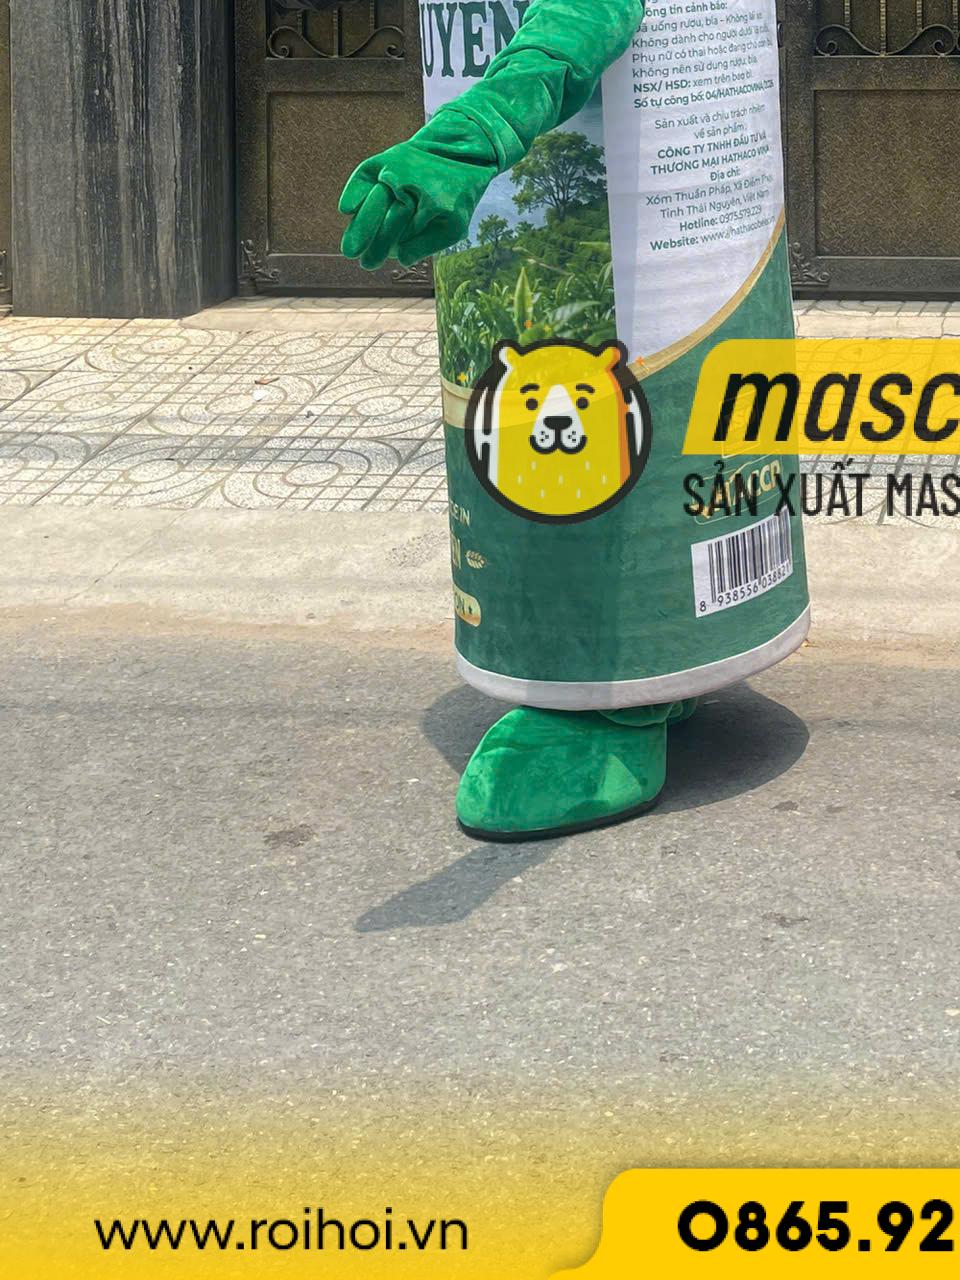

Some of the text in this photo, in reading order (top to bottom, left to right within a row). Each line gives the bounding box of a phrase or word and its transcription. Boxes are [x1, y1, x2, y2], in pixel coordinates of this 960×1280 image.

[657, 144, 691, 159] CÔNG
[693, 143, 705, 155] TY
[707, 139, 732, 152] TNHH
[650, 158, 700, 176] THƯƠNG
[679, 216, 718, 232] Hotline:
[650, 235, 699, 251] Website:
[700, 600, 707, 612] 8
[717, 583, 759, 606] 938556
